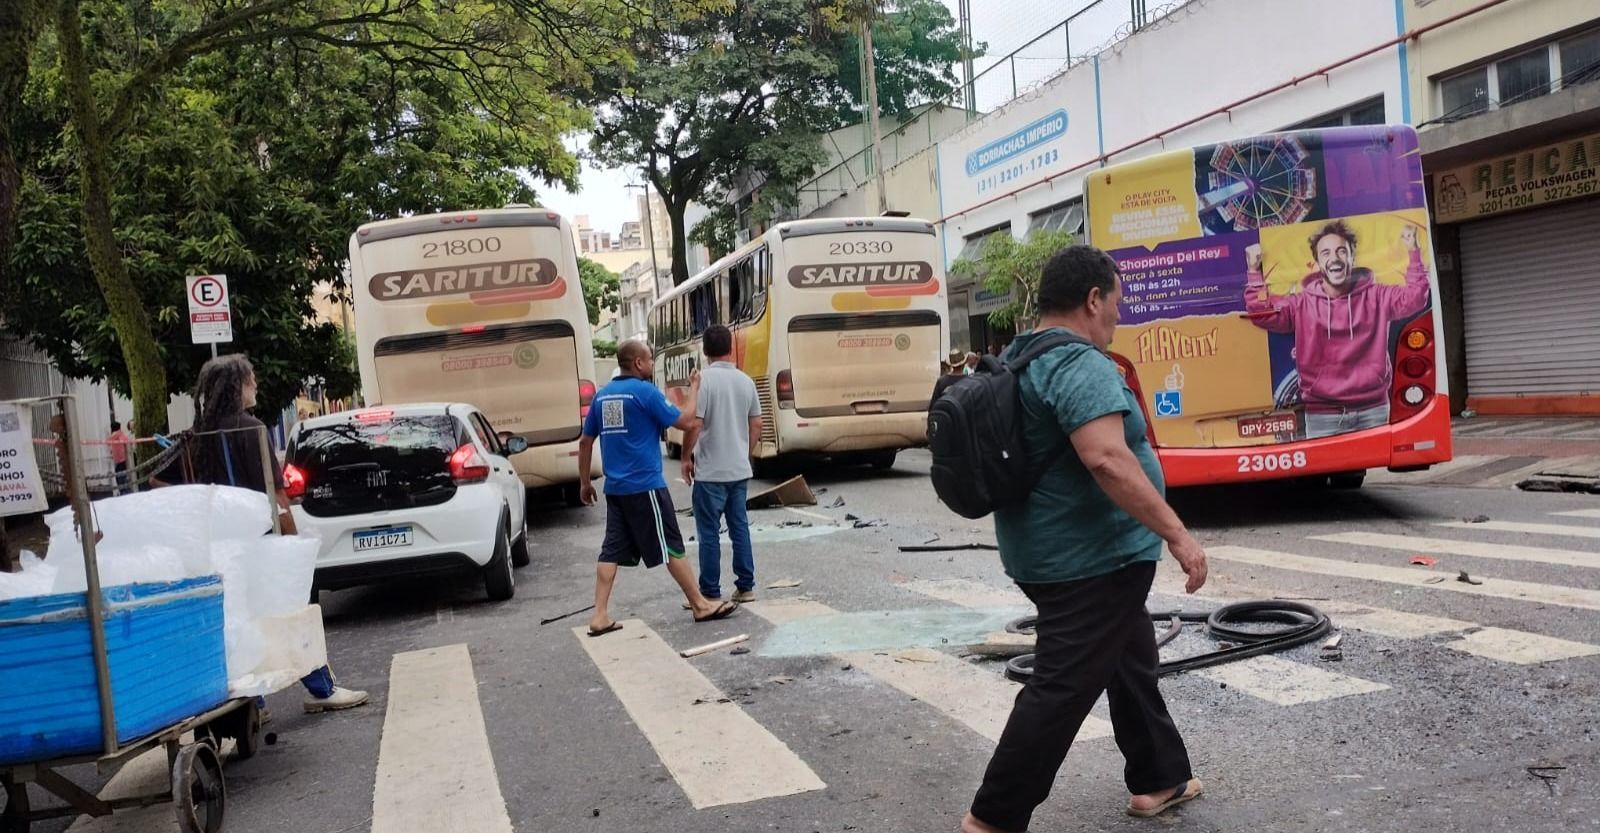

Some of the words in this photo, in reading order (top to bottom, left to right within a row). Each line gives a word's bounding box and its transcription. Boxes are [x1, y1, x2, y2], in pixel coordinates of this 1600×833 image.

[978, 136, 1025, 167] BORRACHAS
[1026, 117, 1063, 145] IMPÉRIO
[977, 175, 997, 195] (31)
[1000, 149, 1058, 183] 3201-1783
[1472, 136, 1600, 193] REICA
[1485, 184, 1518, 200] PEÇAS
[1520, 168, 1596, 192] VOLKSWAGEN
[1125, 194, 1132, 202] O
[1132, 191, 1151, 200] PLAY
[1153, 189, 1170, 198] CITY
[1152, 196, 1177, 205] VOLTA
[1479, 193, 1534, 214] 3201-1204
[1544, 180, 1600, 201] 3272-567
[422, 236, 502, 259] 21800
[829, 240, 893, 256] 20330
[1119, 255, 1174, 271] Shopping
[1176, 252, 1195, 263] Del
[1199, 249, 1221, 260] Rey
[382, 262, 541, 297] SARITUR
[801, 264, 921, 284] SARITUR
[1121, 272, 1146, 282] Terça
[1158, 266, 1183, 277] sexta
[201, 283, 214, 302] E
[1128, 282, 1146, 293] 18h
[1148, 281, 1159, 290] às
[1161, 277, 1180, 288] 22h
[1129, 303, 1147, 314] 16h
[1136, 326, 1218, 364] PLAYCITY
[1238, 451, 1307, 472] 23068
[367, 470, 391, 488] FIAT
[359, 533, 407, 549] RVI1C71
